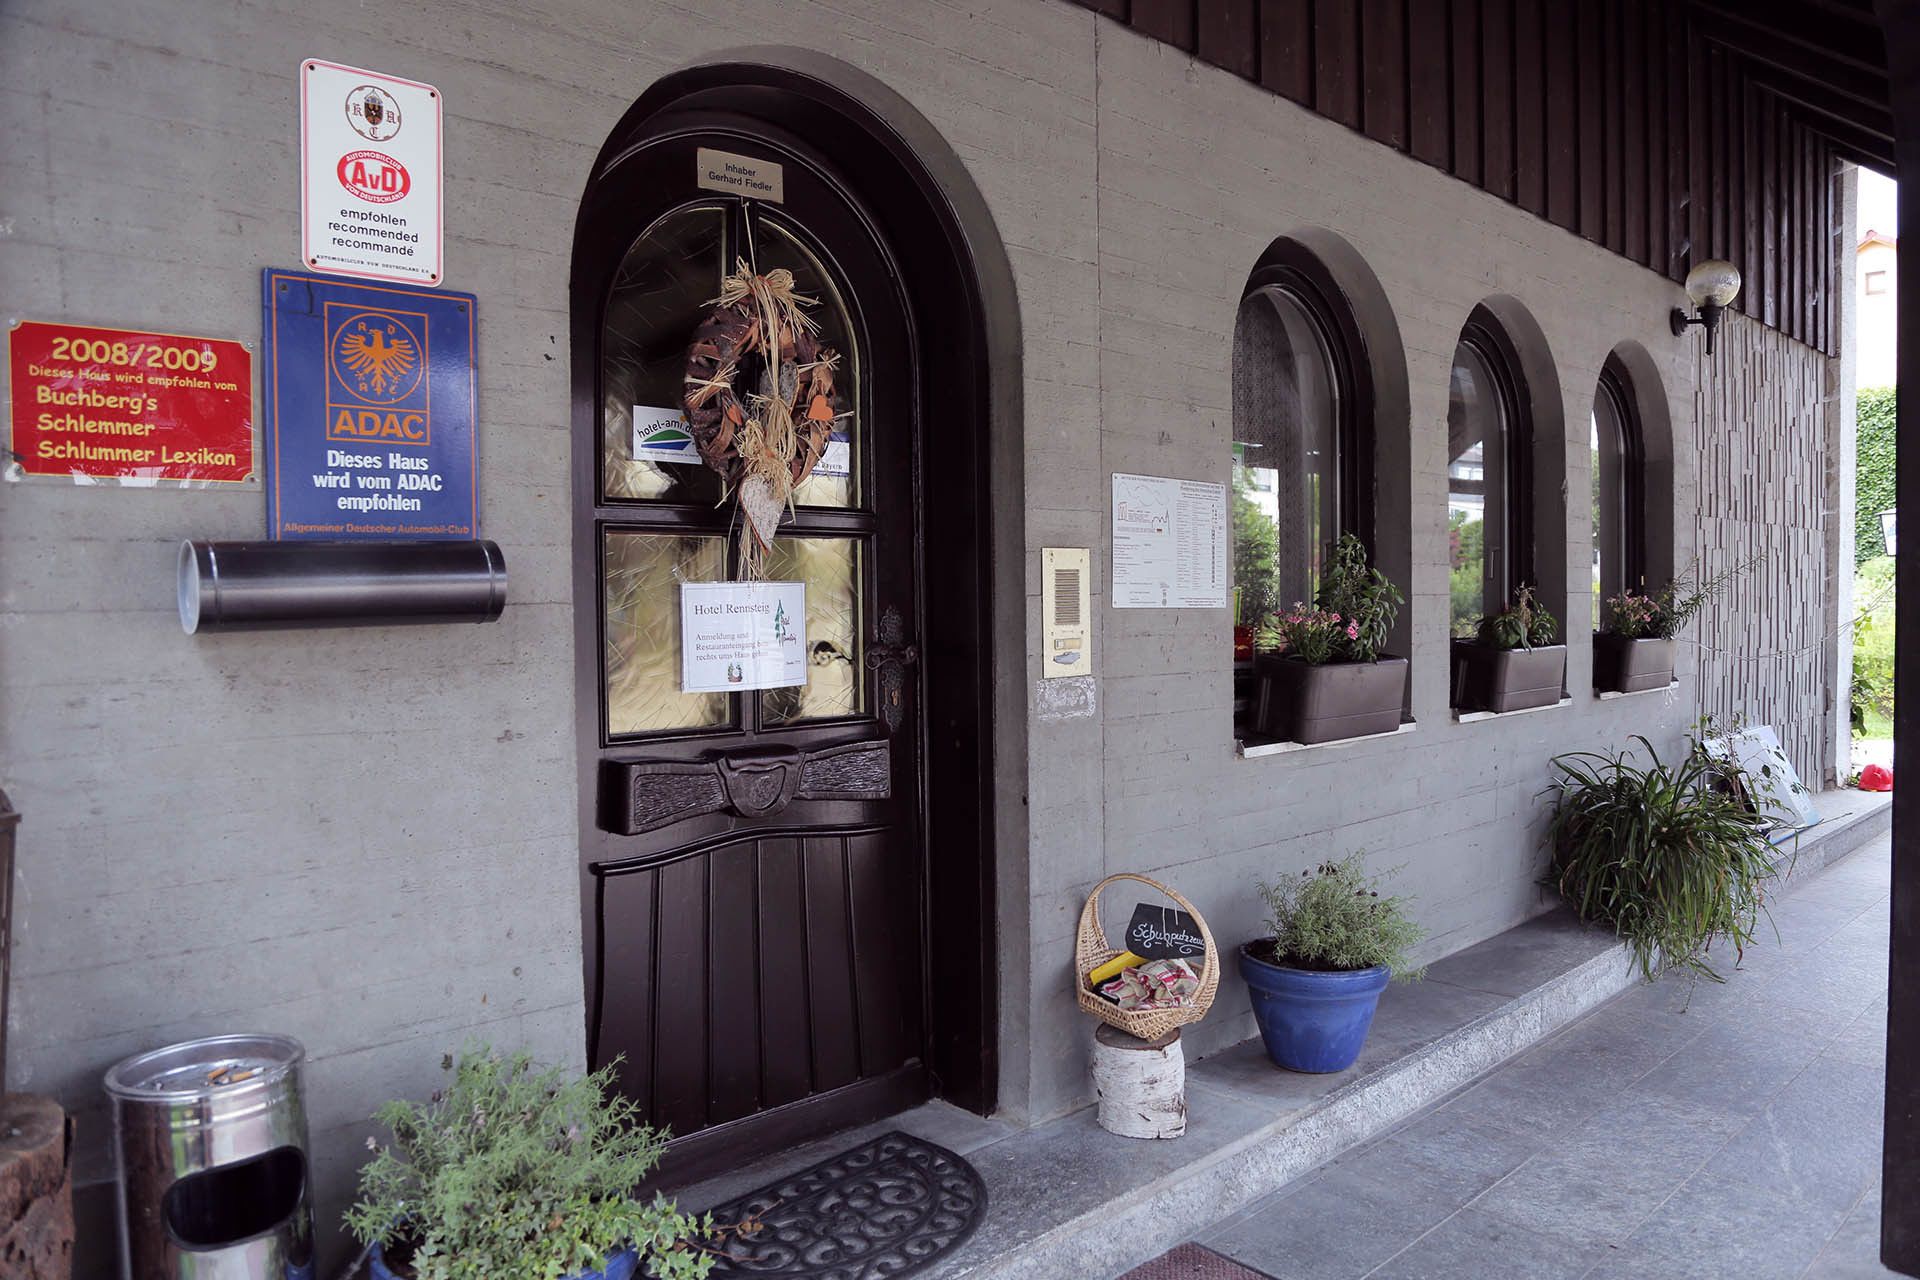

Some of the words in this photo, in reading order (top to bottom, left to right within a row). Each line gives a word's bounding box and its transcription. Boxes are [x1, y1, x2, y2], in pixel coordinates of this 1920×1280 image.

[345, 151, 403, 171] AUTOMOBILCLUB
[725, 163, 756, 176] Inhaber
[351, 161, 398, 193] AvD
[708, 171, 743, 186] Gerhard
[745, 178, 773, 192] Fiedler
[359, 191, 405, 204] DEUTSCHLAND
[340, 208, 407, 227] empfohlen
[328, 221, 419, 243] recommended
[332, 236, 414, 257] recommandé
[52, 337, 217, 371] 2008/2009
[28, 364, 75, 379] Dieses
[79, 368, 111, 381] Haus
[115, 372, 144, 384] wird
[147, 376, 211, 391] empfohlen
[214, 382, 237, 391] vom
[37, 385, 158, 414] Buchberg's
[36, 413, 156, 436] Schlemmer
[333, 410, 424, 440] ADAC
[37, 440, 156, 463] Schlummer
[161, 445, 236, 466] Lexikon
[327, 450, 382, 469] Dieses
[388, 453, 429, 470] Haus
[313, 471, 350, 489] wird
[356, 476, 391, 490] vom
[397, 474, 442, 492] ADAC
[337, 494, 421, 513] empfohlen
[284, 522, 344, 534] Allgemeiner
[346, 523, 396, 534] Deutscher
[398, 524, 470, 535] Automobil-Club
[695, 605, 722, 615] Hotel
[726, 602, 770, 615] Rennsteig
